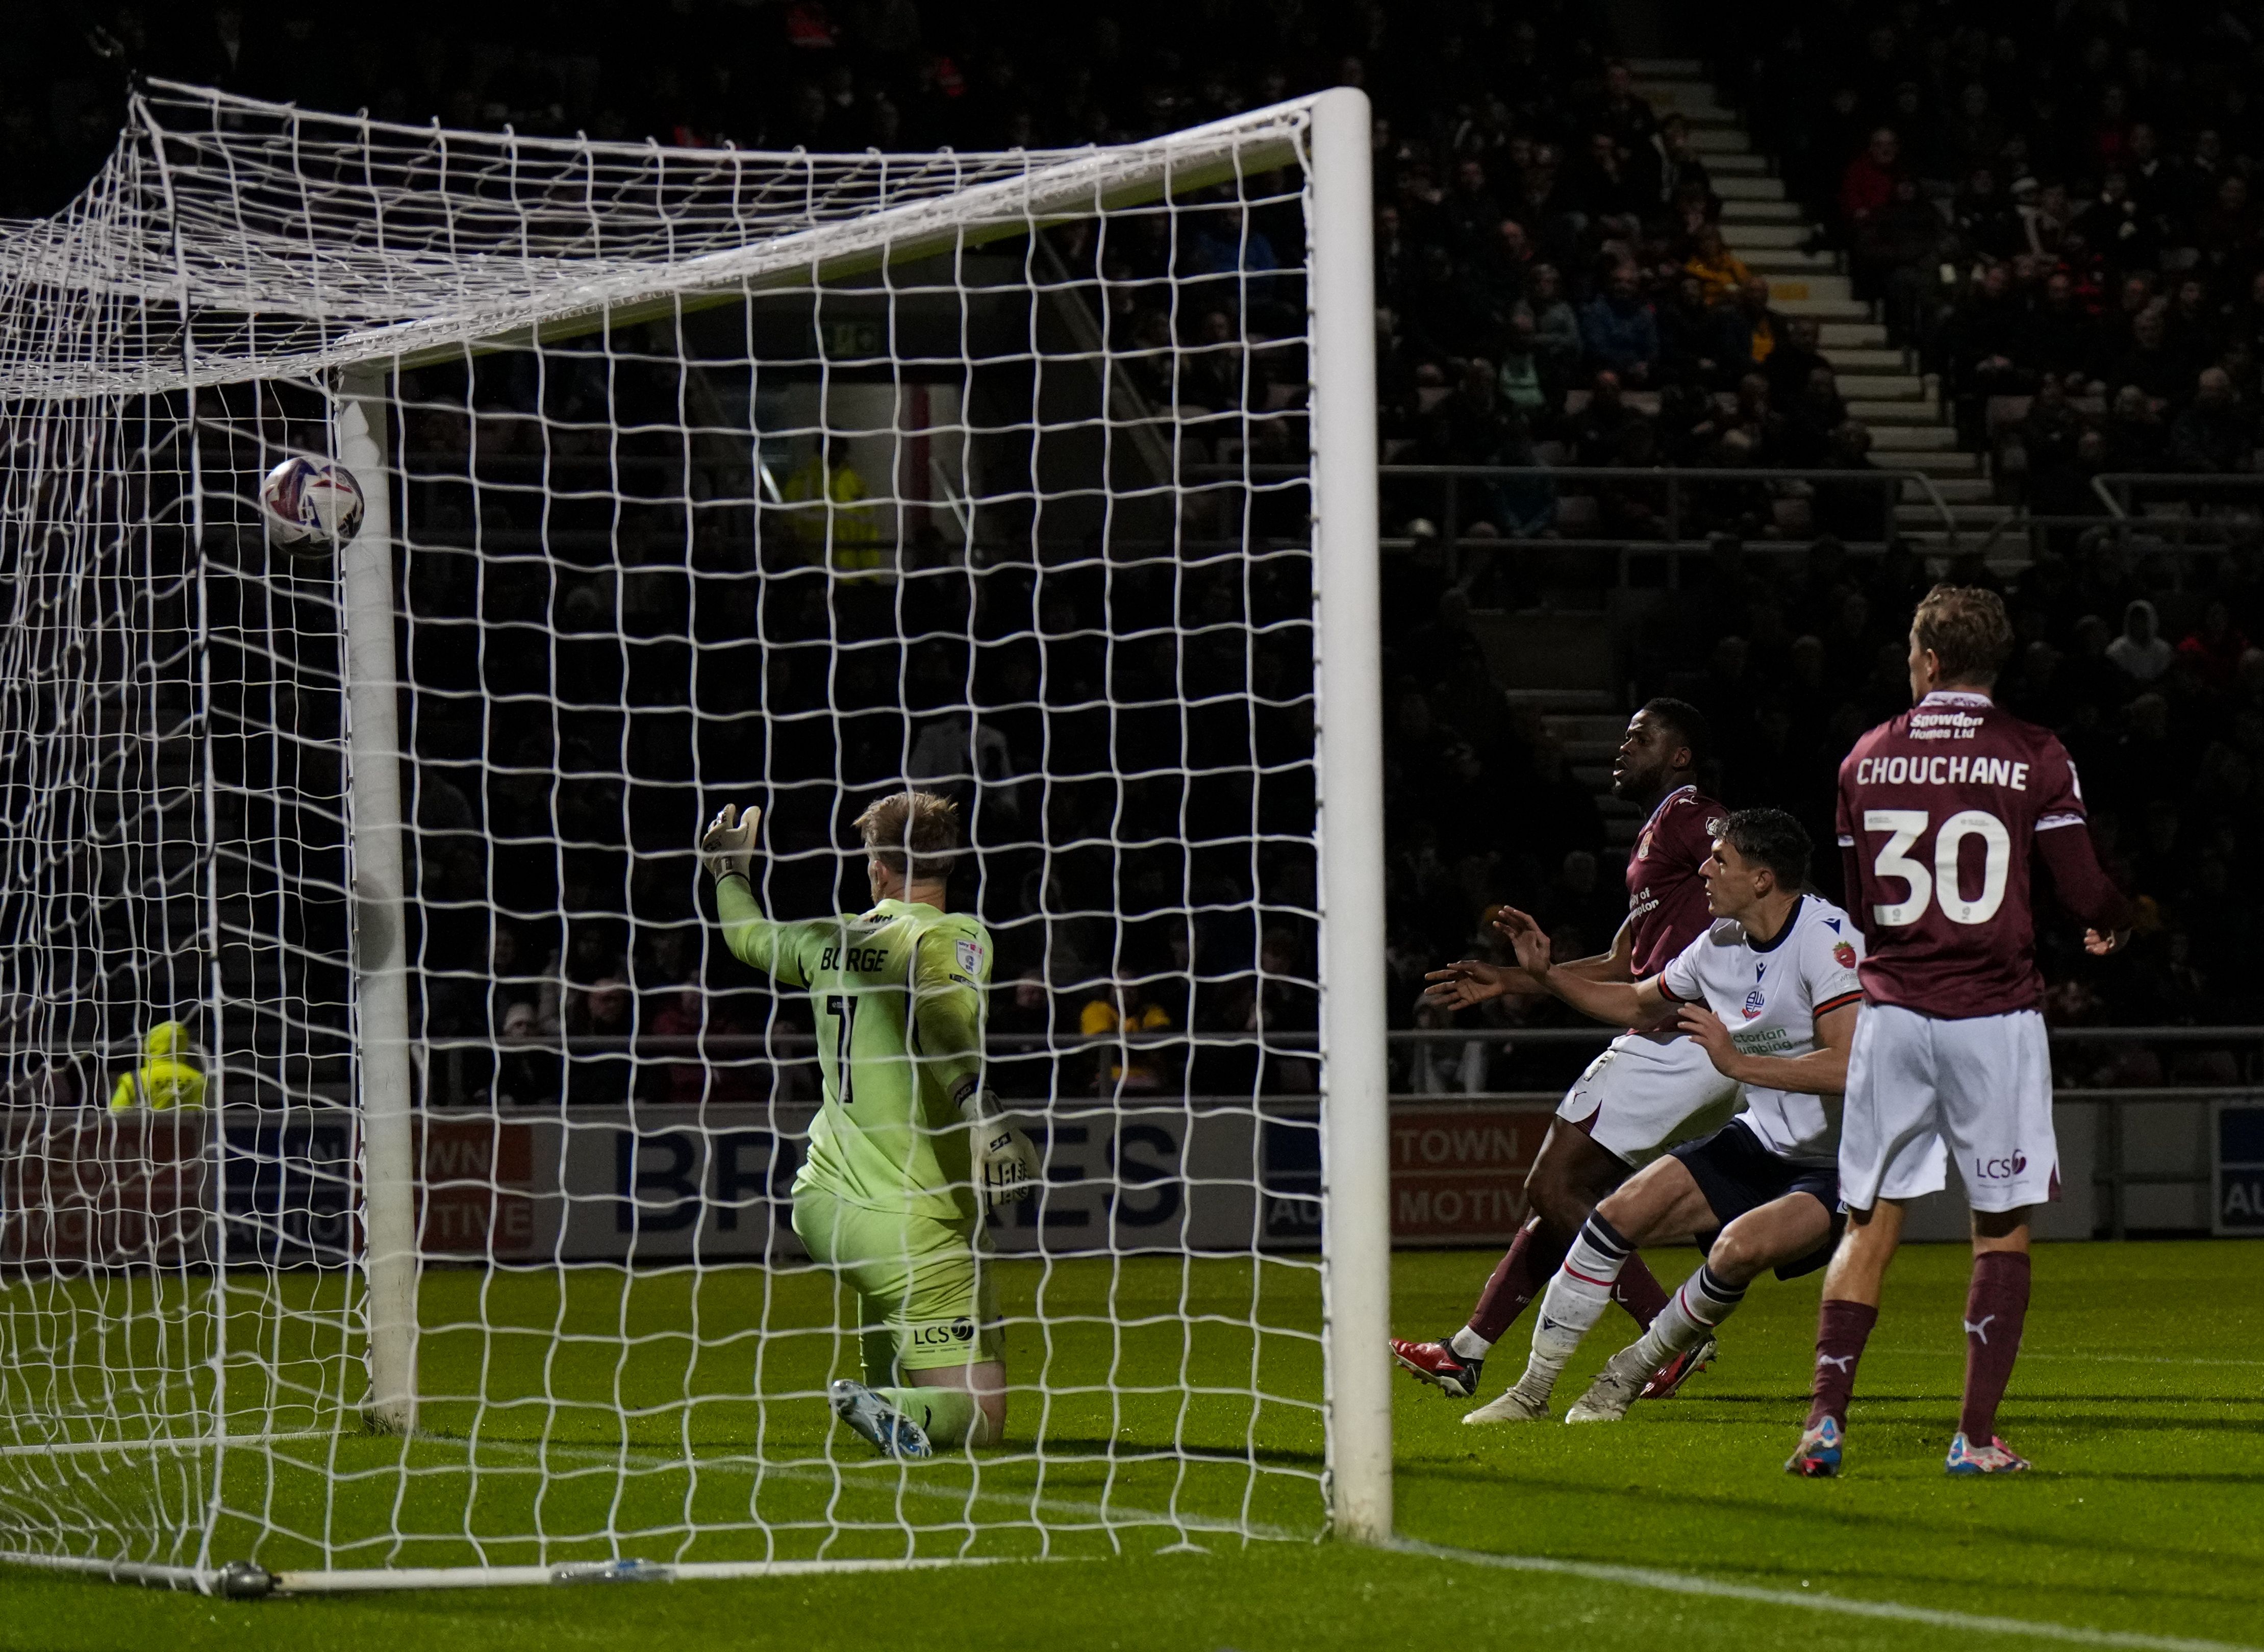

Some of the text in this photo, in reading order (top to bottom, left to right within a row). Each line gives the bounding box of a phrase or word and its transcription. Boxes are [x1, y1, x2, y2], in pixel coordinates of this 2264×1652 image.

[1910, 711, 1984, 728] Snowdon
[1909, 728, 1975, 739] Homes Ltd
[1857, 756, 2029, 791] CHOUCHANE
[1864, 810, 2010, 927] 30
[1732, 1028, 1787, 1043] ctorian
[1394, 1128, 1519, 1163] TOWN
[1976, 1158, 2010, 1179] LCS
[1398, 1189, 1528, 1223] MOTIV
[914, 1326, 949, 1345] LCS
